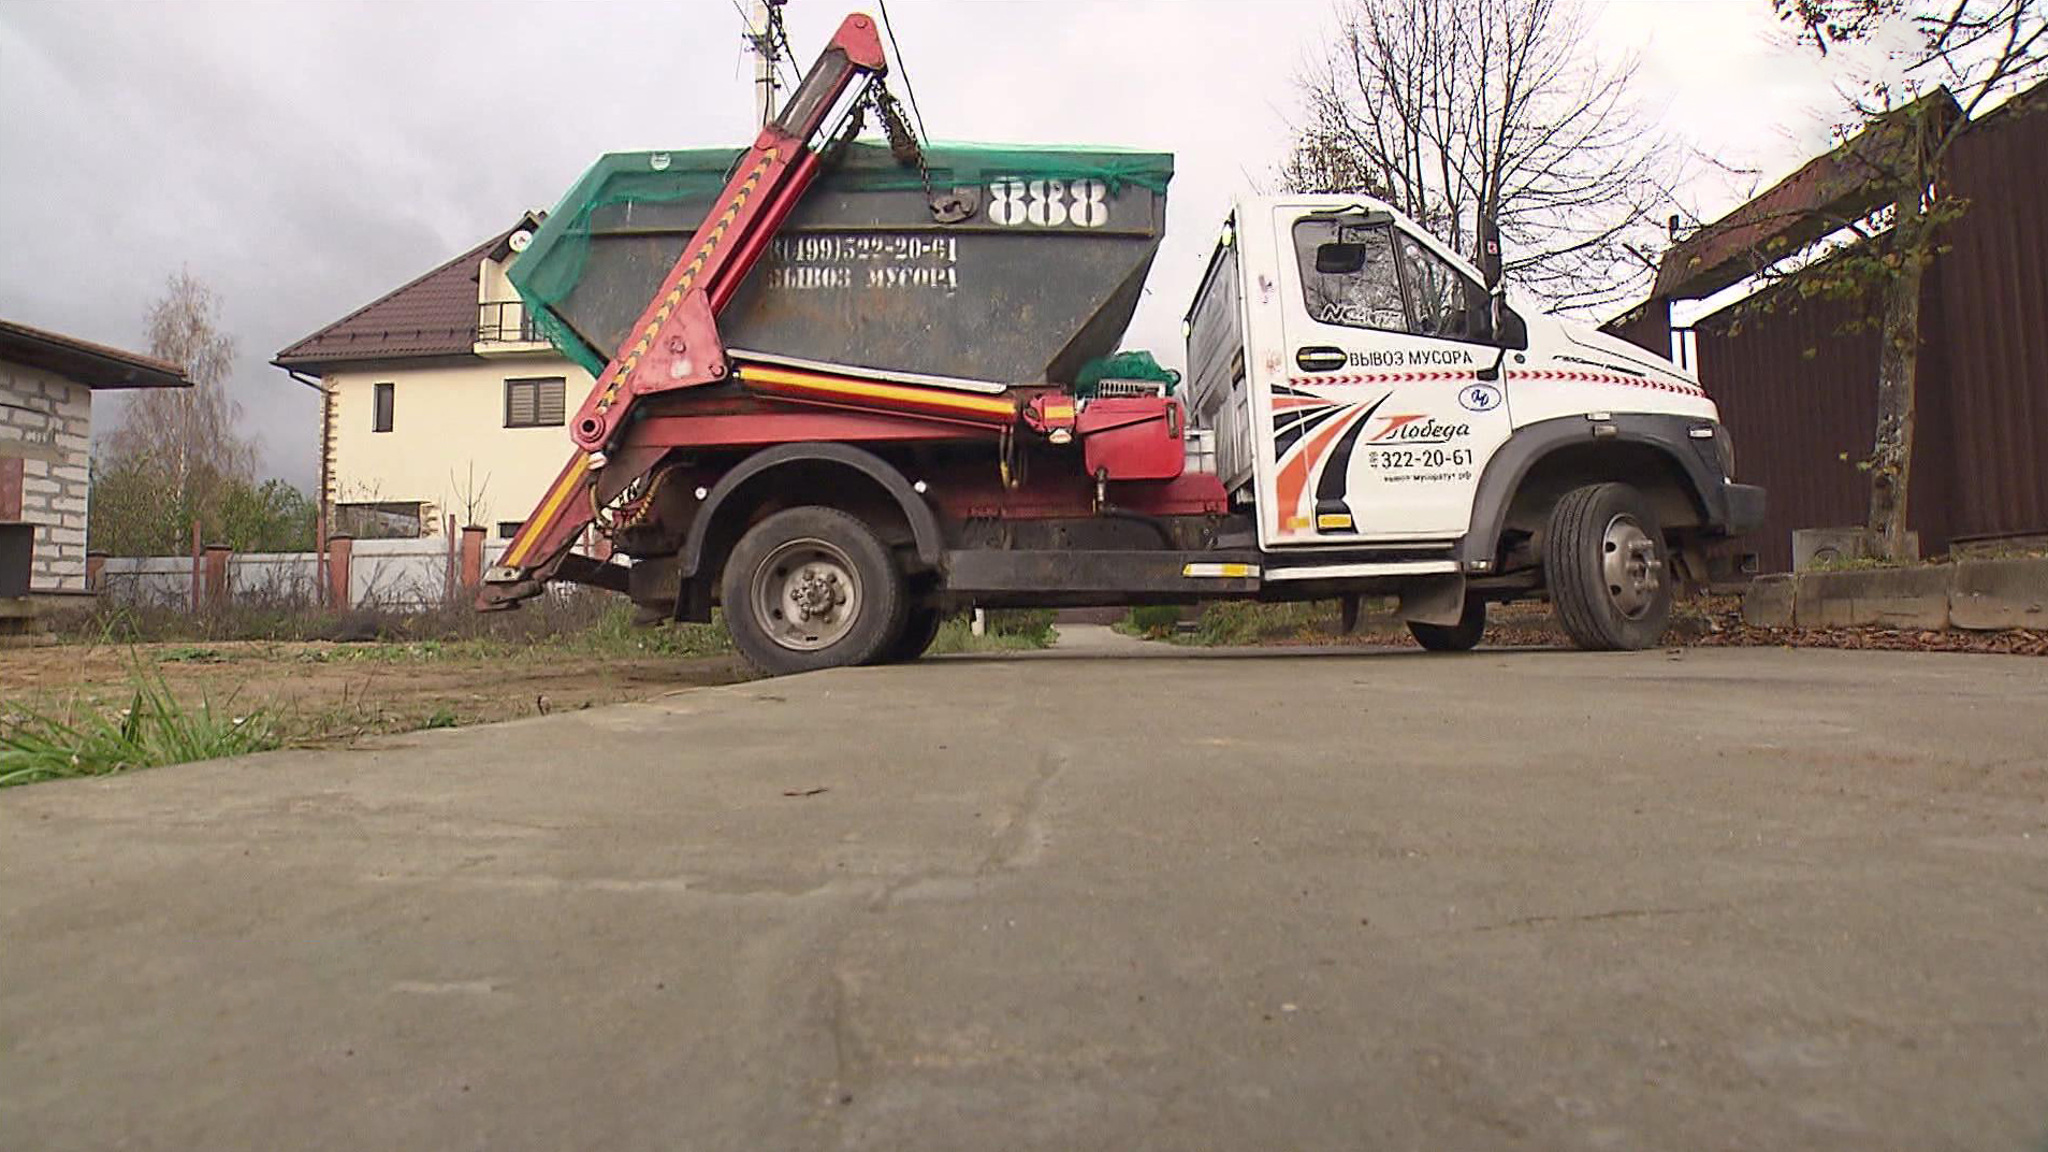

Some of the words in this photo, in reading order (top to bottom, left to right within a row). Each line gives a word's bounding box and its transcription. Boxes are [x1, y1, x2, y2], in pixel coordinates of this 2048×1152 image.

[988, 177, 1108, 228] 888
[1350, 352, 1404, 367] ВЫВОЗ
[1408, 350, 1474, 366] МУСОРА
[1370, 414, 1471, 442] Победа
[1381, 448, 1473, 469] 322-20-61
